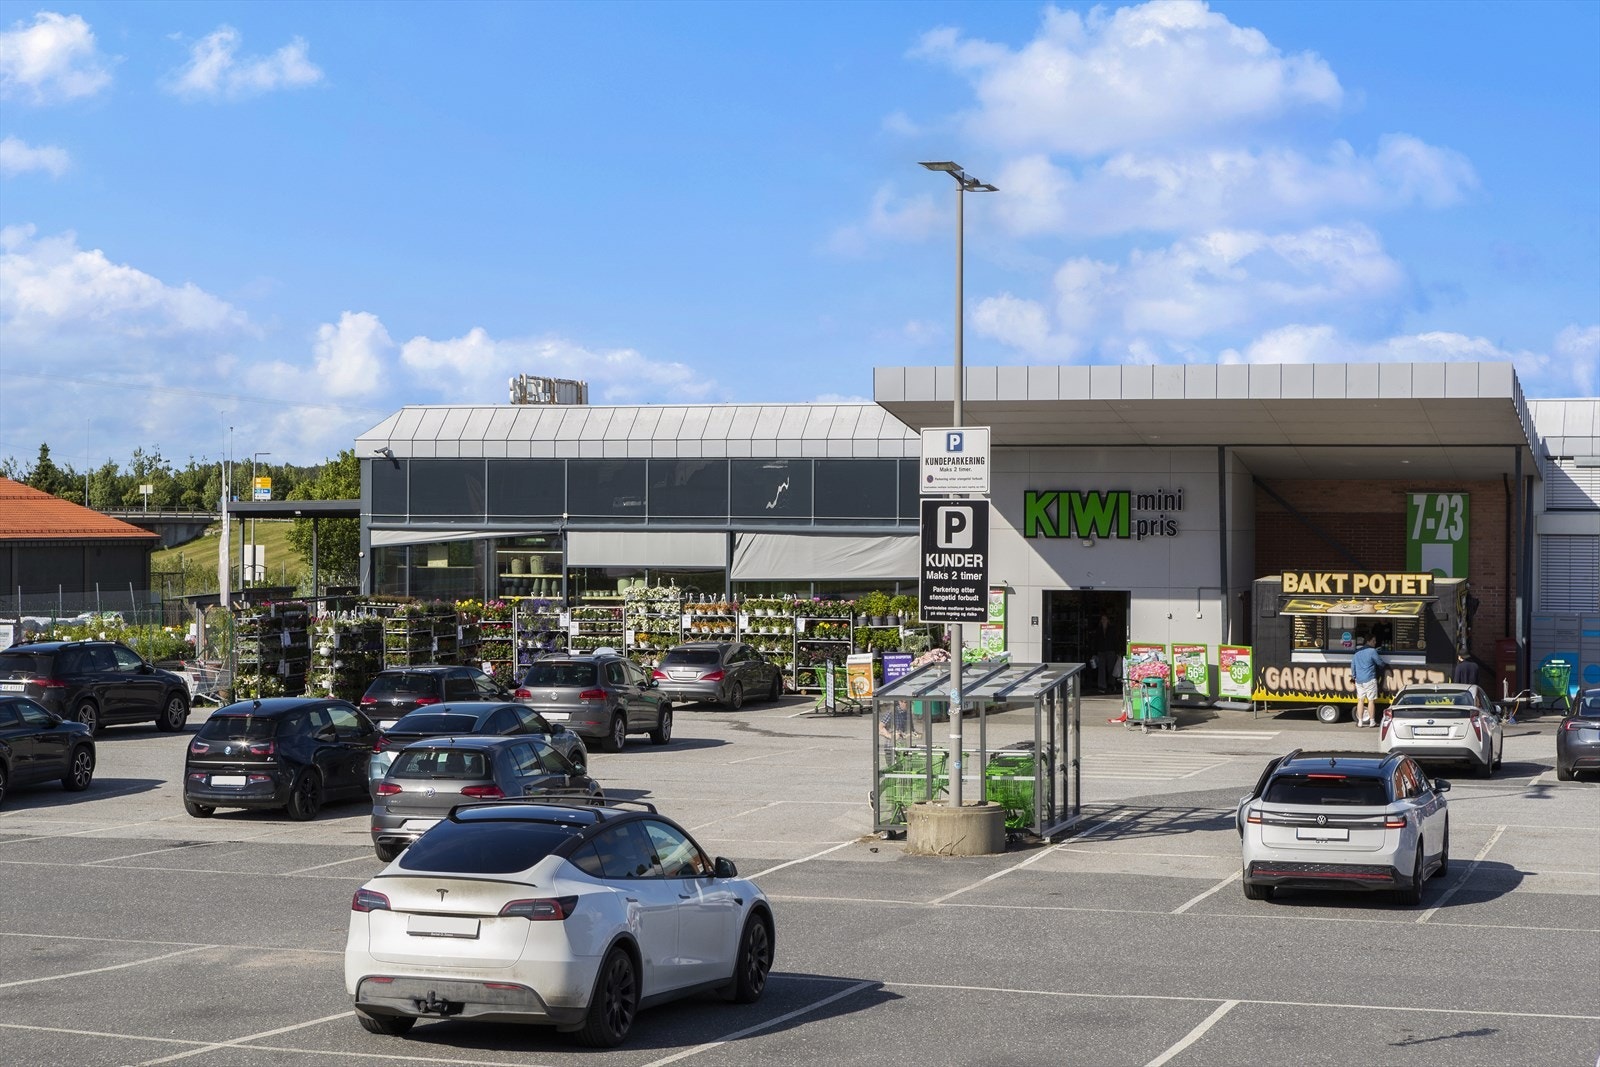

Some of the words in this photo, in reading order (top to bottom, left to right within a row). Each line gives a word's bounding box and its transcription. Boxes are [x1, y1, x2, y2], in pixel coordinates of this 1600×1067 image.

[950, 434, 960, 450] P
[925, 456, 985, 466] KUNDEPARKERING
[1136, 488, 1183, 511] mini
[1024, 490, 1131, 538] KIWI
[1412, 494, 1464, 541] 7-23
[945, 511, 966, 544] P
[1136, 514, 1178, 541] pris
[926, 554, 984, 568] KUNDER
[926, 571, 948, 580] Maks
[951, 571, 958, 580] 2
[960, 571, 983, 580] timer
[1282, 572, 1348, 594] BAKT
[1353, 573, 1432, 595] POTET
[932, 586, 960, 594] Parkering
[1266, 666, 1356, 692] GARANTE
